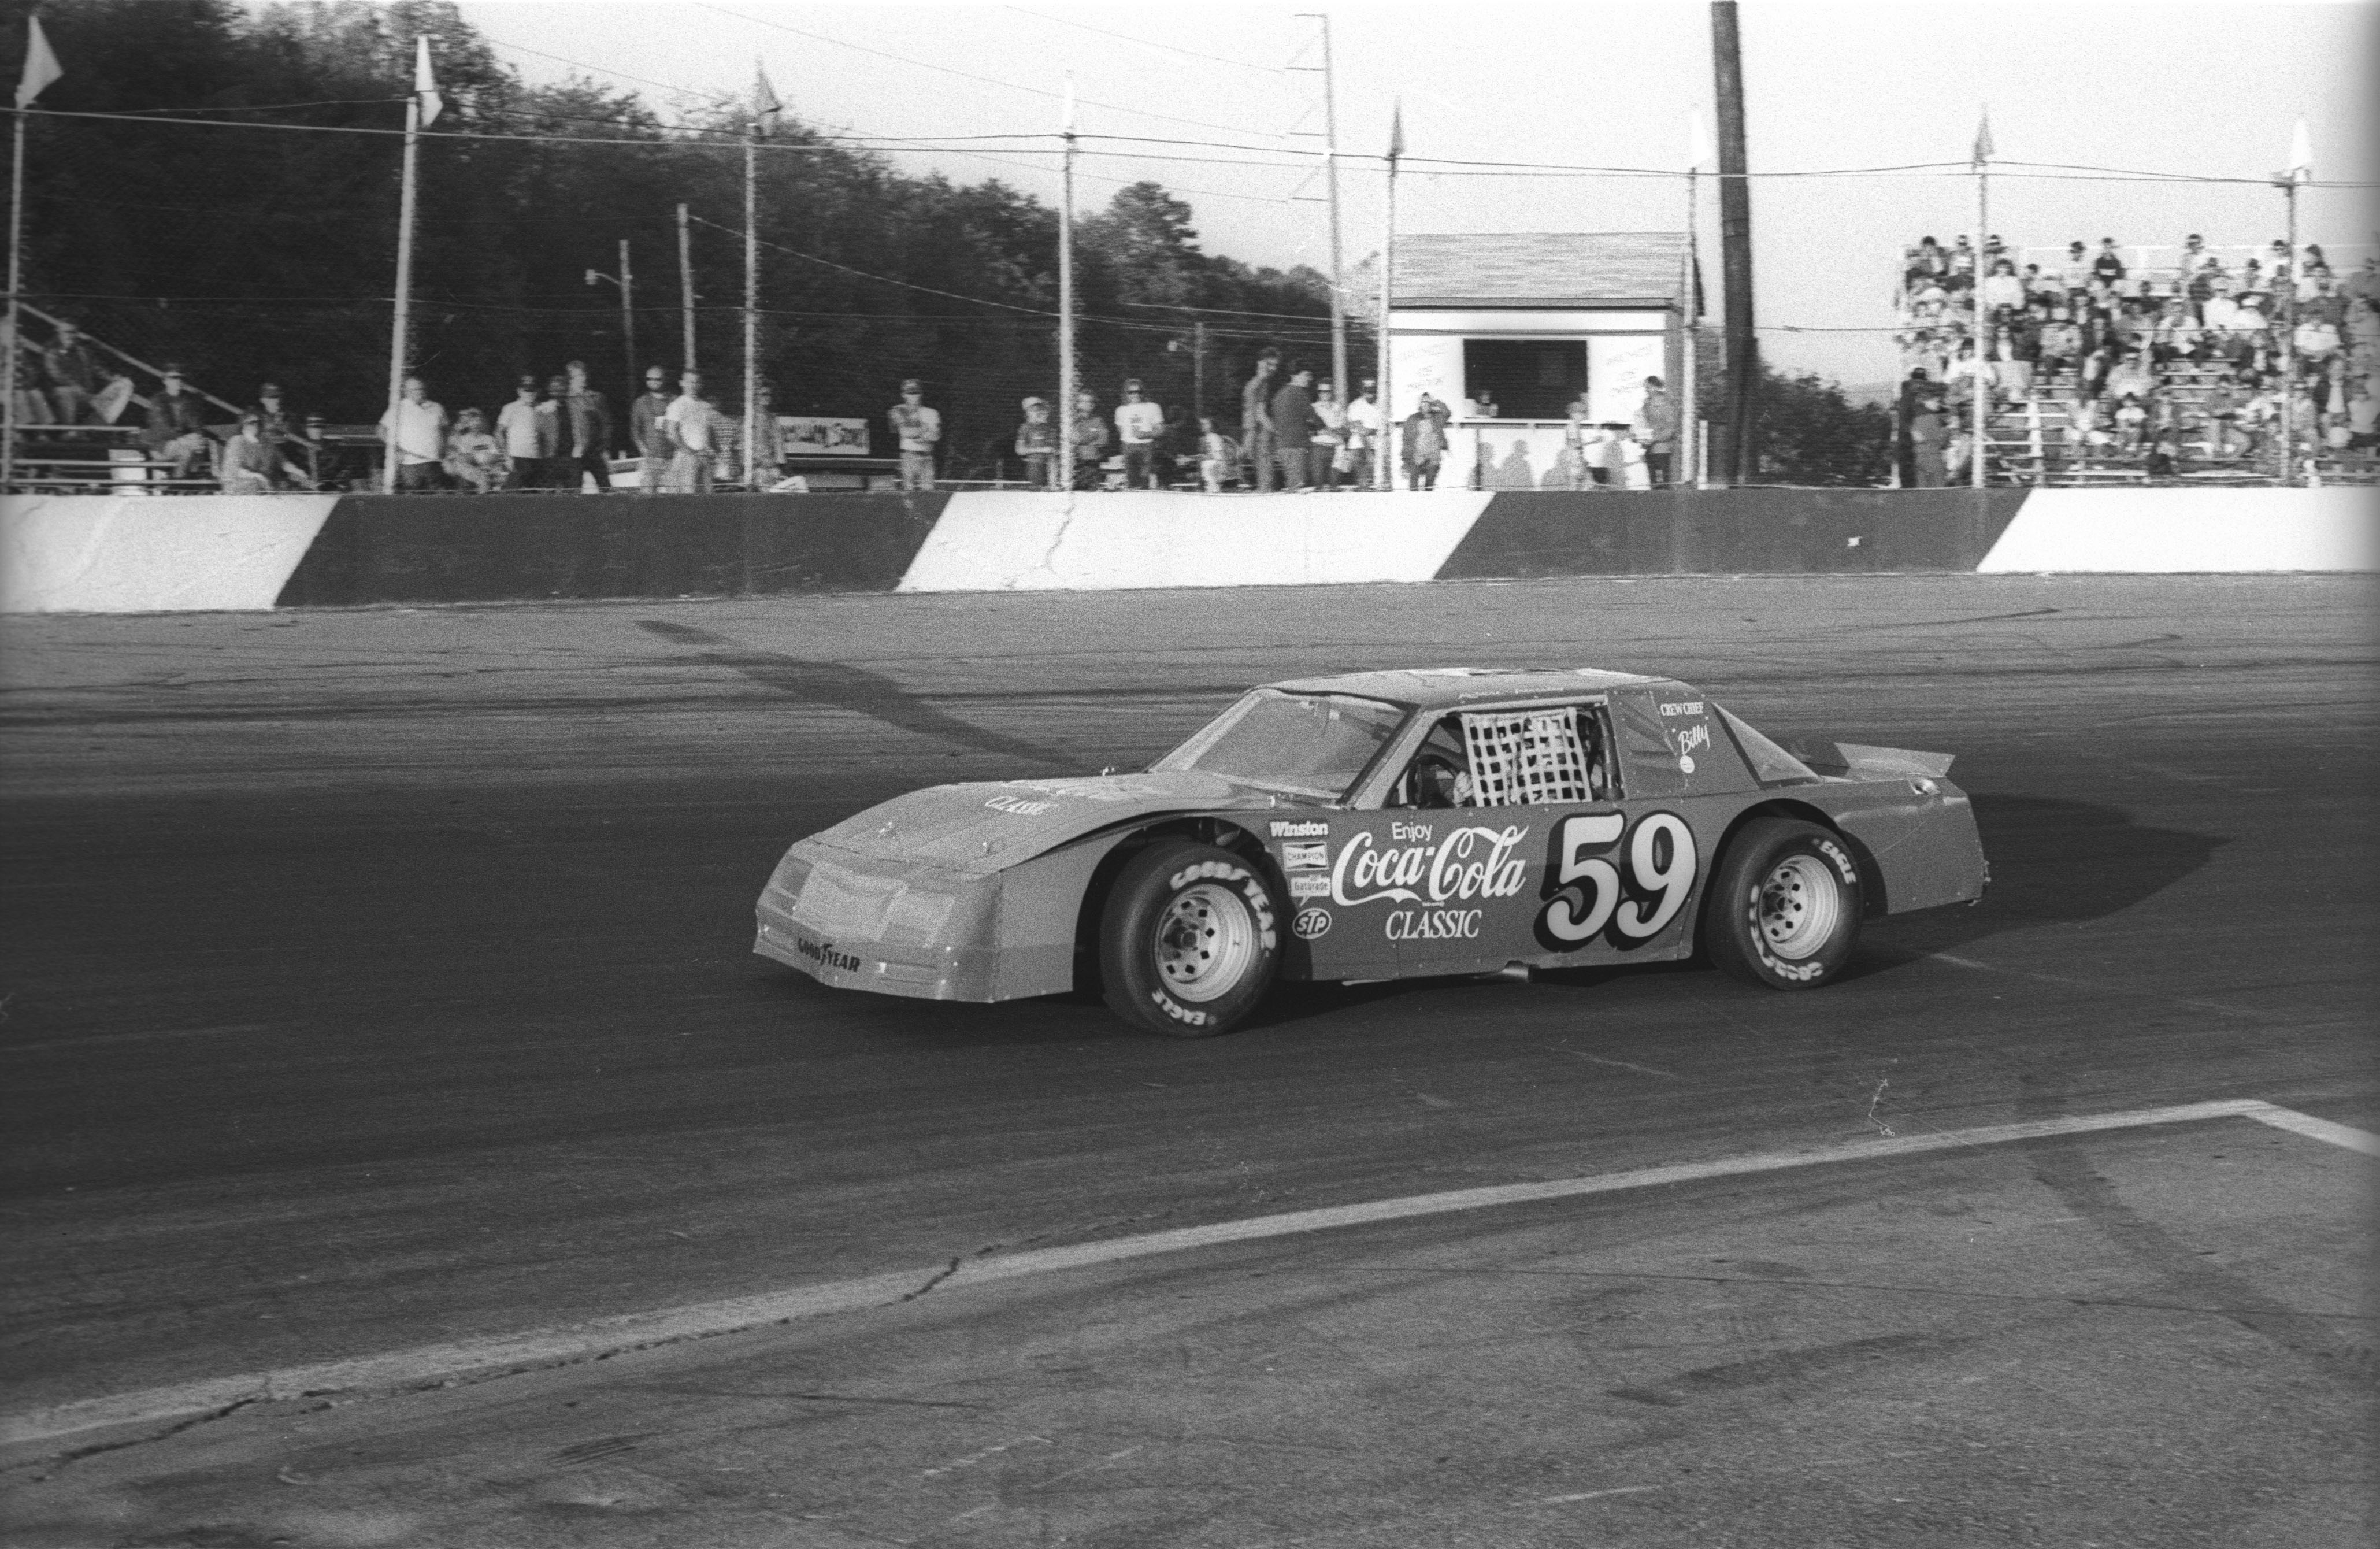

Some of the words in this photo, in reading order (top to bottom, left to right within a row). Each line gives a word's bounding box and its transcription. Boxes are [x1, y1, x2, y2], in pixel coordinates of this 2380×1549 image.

[1660, 703, 1682, 716] CREW
[1678, 725, 1710, 755] Billy
[1270, 820, 1329, 837] Winston
[1392, 822, 1432, 841] Enjoy
[1288, 851, 1325, 861] CHAMPION
[1332, 825, 1529, 906] Coca-Cola
[1294, 881, 1329, 891] Gatorade
[1537, 811, 1698, 948] 59
[1296, 911, 1328, 933] STP
[1385, 910, 1482, 940] CLASSIC
